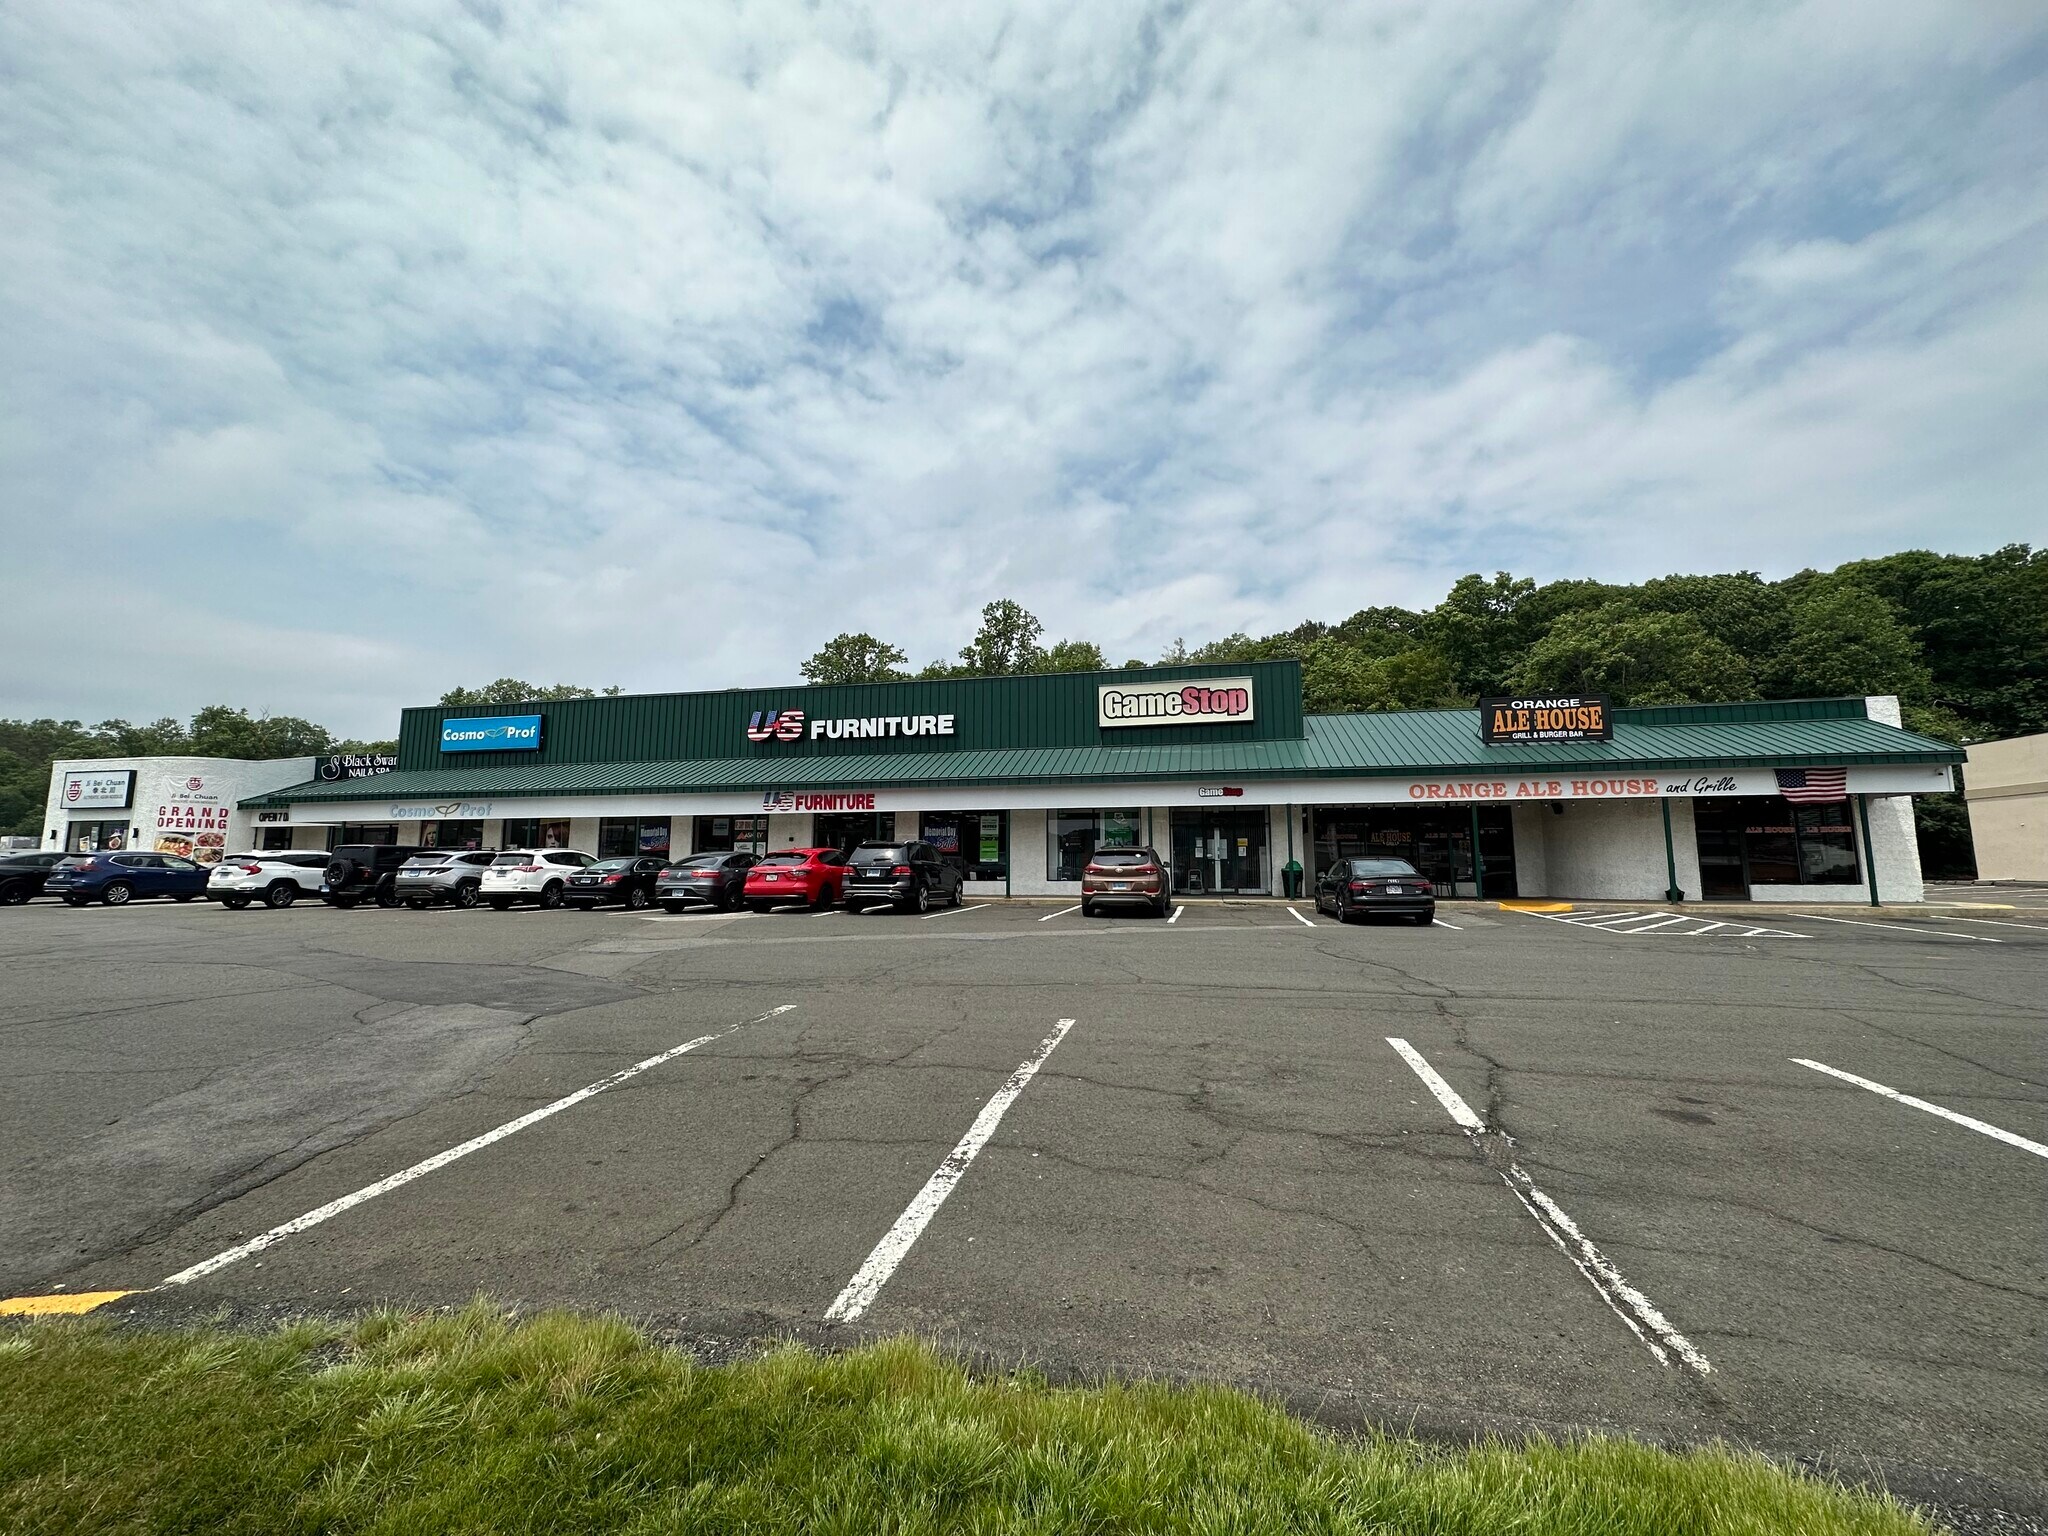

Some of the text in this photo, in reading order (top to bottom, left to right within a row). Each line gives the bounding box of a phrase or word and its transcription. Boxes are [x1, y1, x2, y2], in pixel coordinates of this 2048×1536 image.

[1103, 686, 1249, 719] GameStop
[1511, 699, 1580, 709] ORANGE
[747, 708, 955, 742] US FURNITURE
[1493, 706, 1603, 733] ALE HOUSE
[443, 725, 536, 741] Cosmo Prof
[342, 754, 372, 767] Black
[348, 768, 367, 777] NAIL
[367, 768, 374, 776] &
[1409, 776, 1738, 799] ORANGE ALE HOUSE and Grille
[763, 791, 875, 811] US FURNITURE
[158, 805, 229, 818] GRAND
[259, 812, 277, 822] OPEN
[277, 812, 283, 822] 7
[389, 803, 493, 818] Cosmo Prof
[157, 817, 228, 829] OPENING
[1371, 832, 1412, 843] ALE HOUSE
